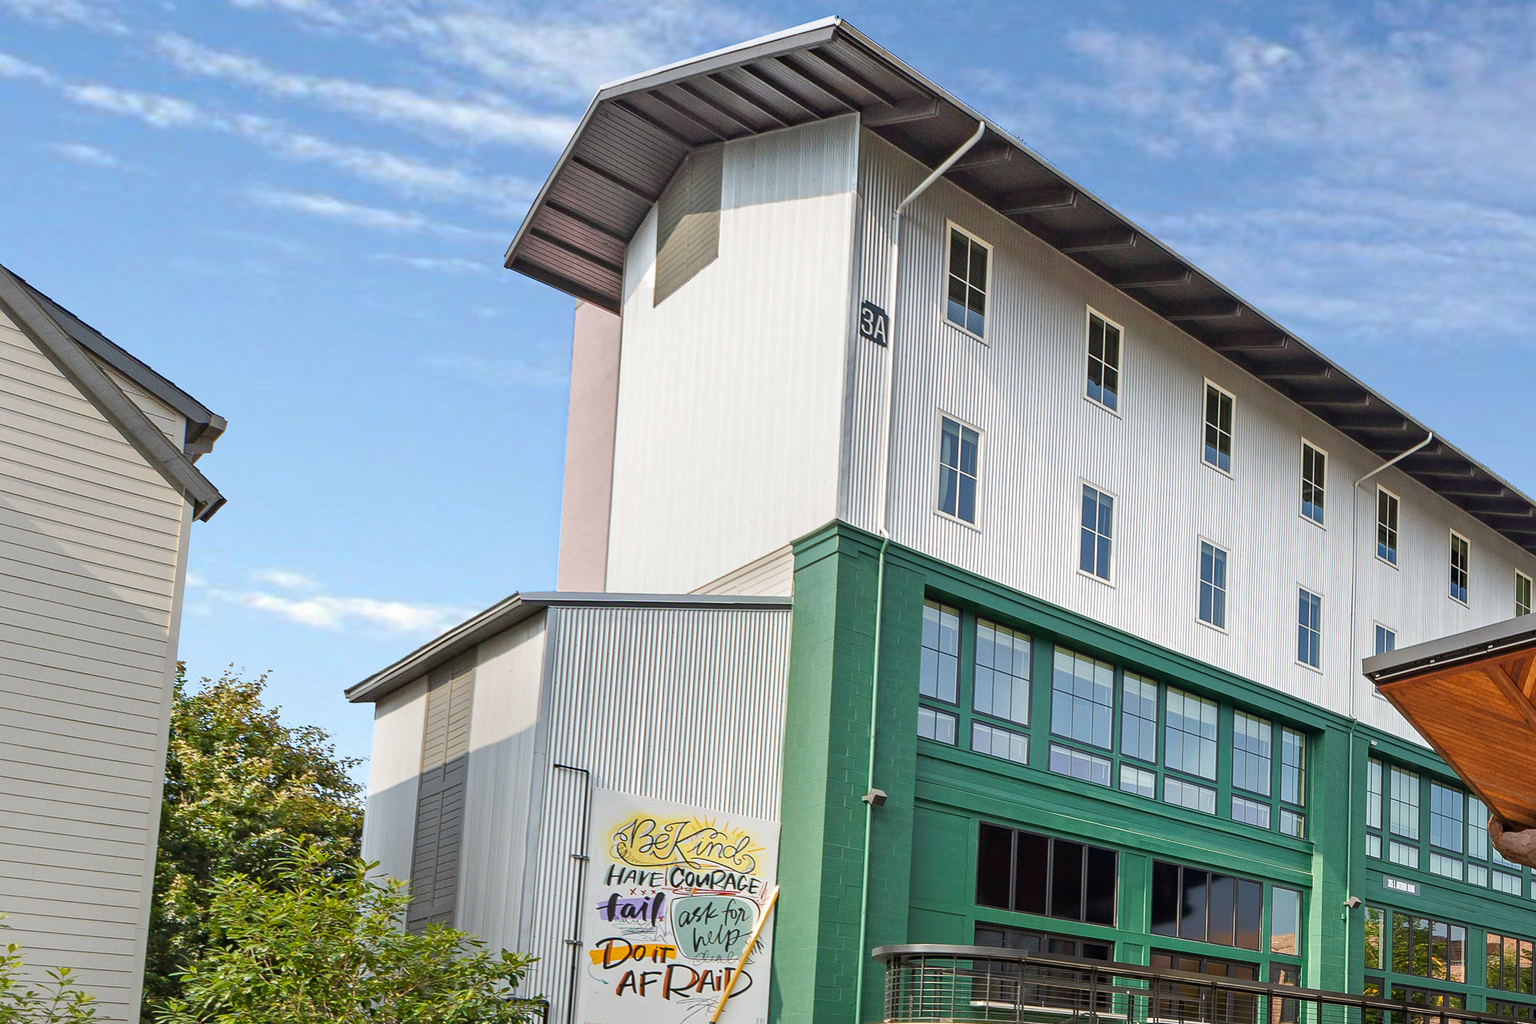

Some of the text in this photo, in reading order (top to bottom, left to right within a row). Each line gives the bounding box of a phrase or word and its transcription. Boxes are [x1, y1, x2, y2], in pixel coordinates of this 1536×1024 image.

[861, 307, 888, 344] 3A
[612, 818, 755, 872] Be Kind
[606, 863, 761, 895] HAVE COURAGE
[596, 892, 666, 928] fail
[678, 898, 750, 928] ask for
[595, 936, 646, 970] Do
[692, 924, 753, 953] help
